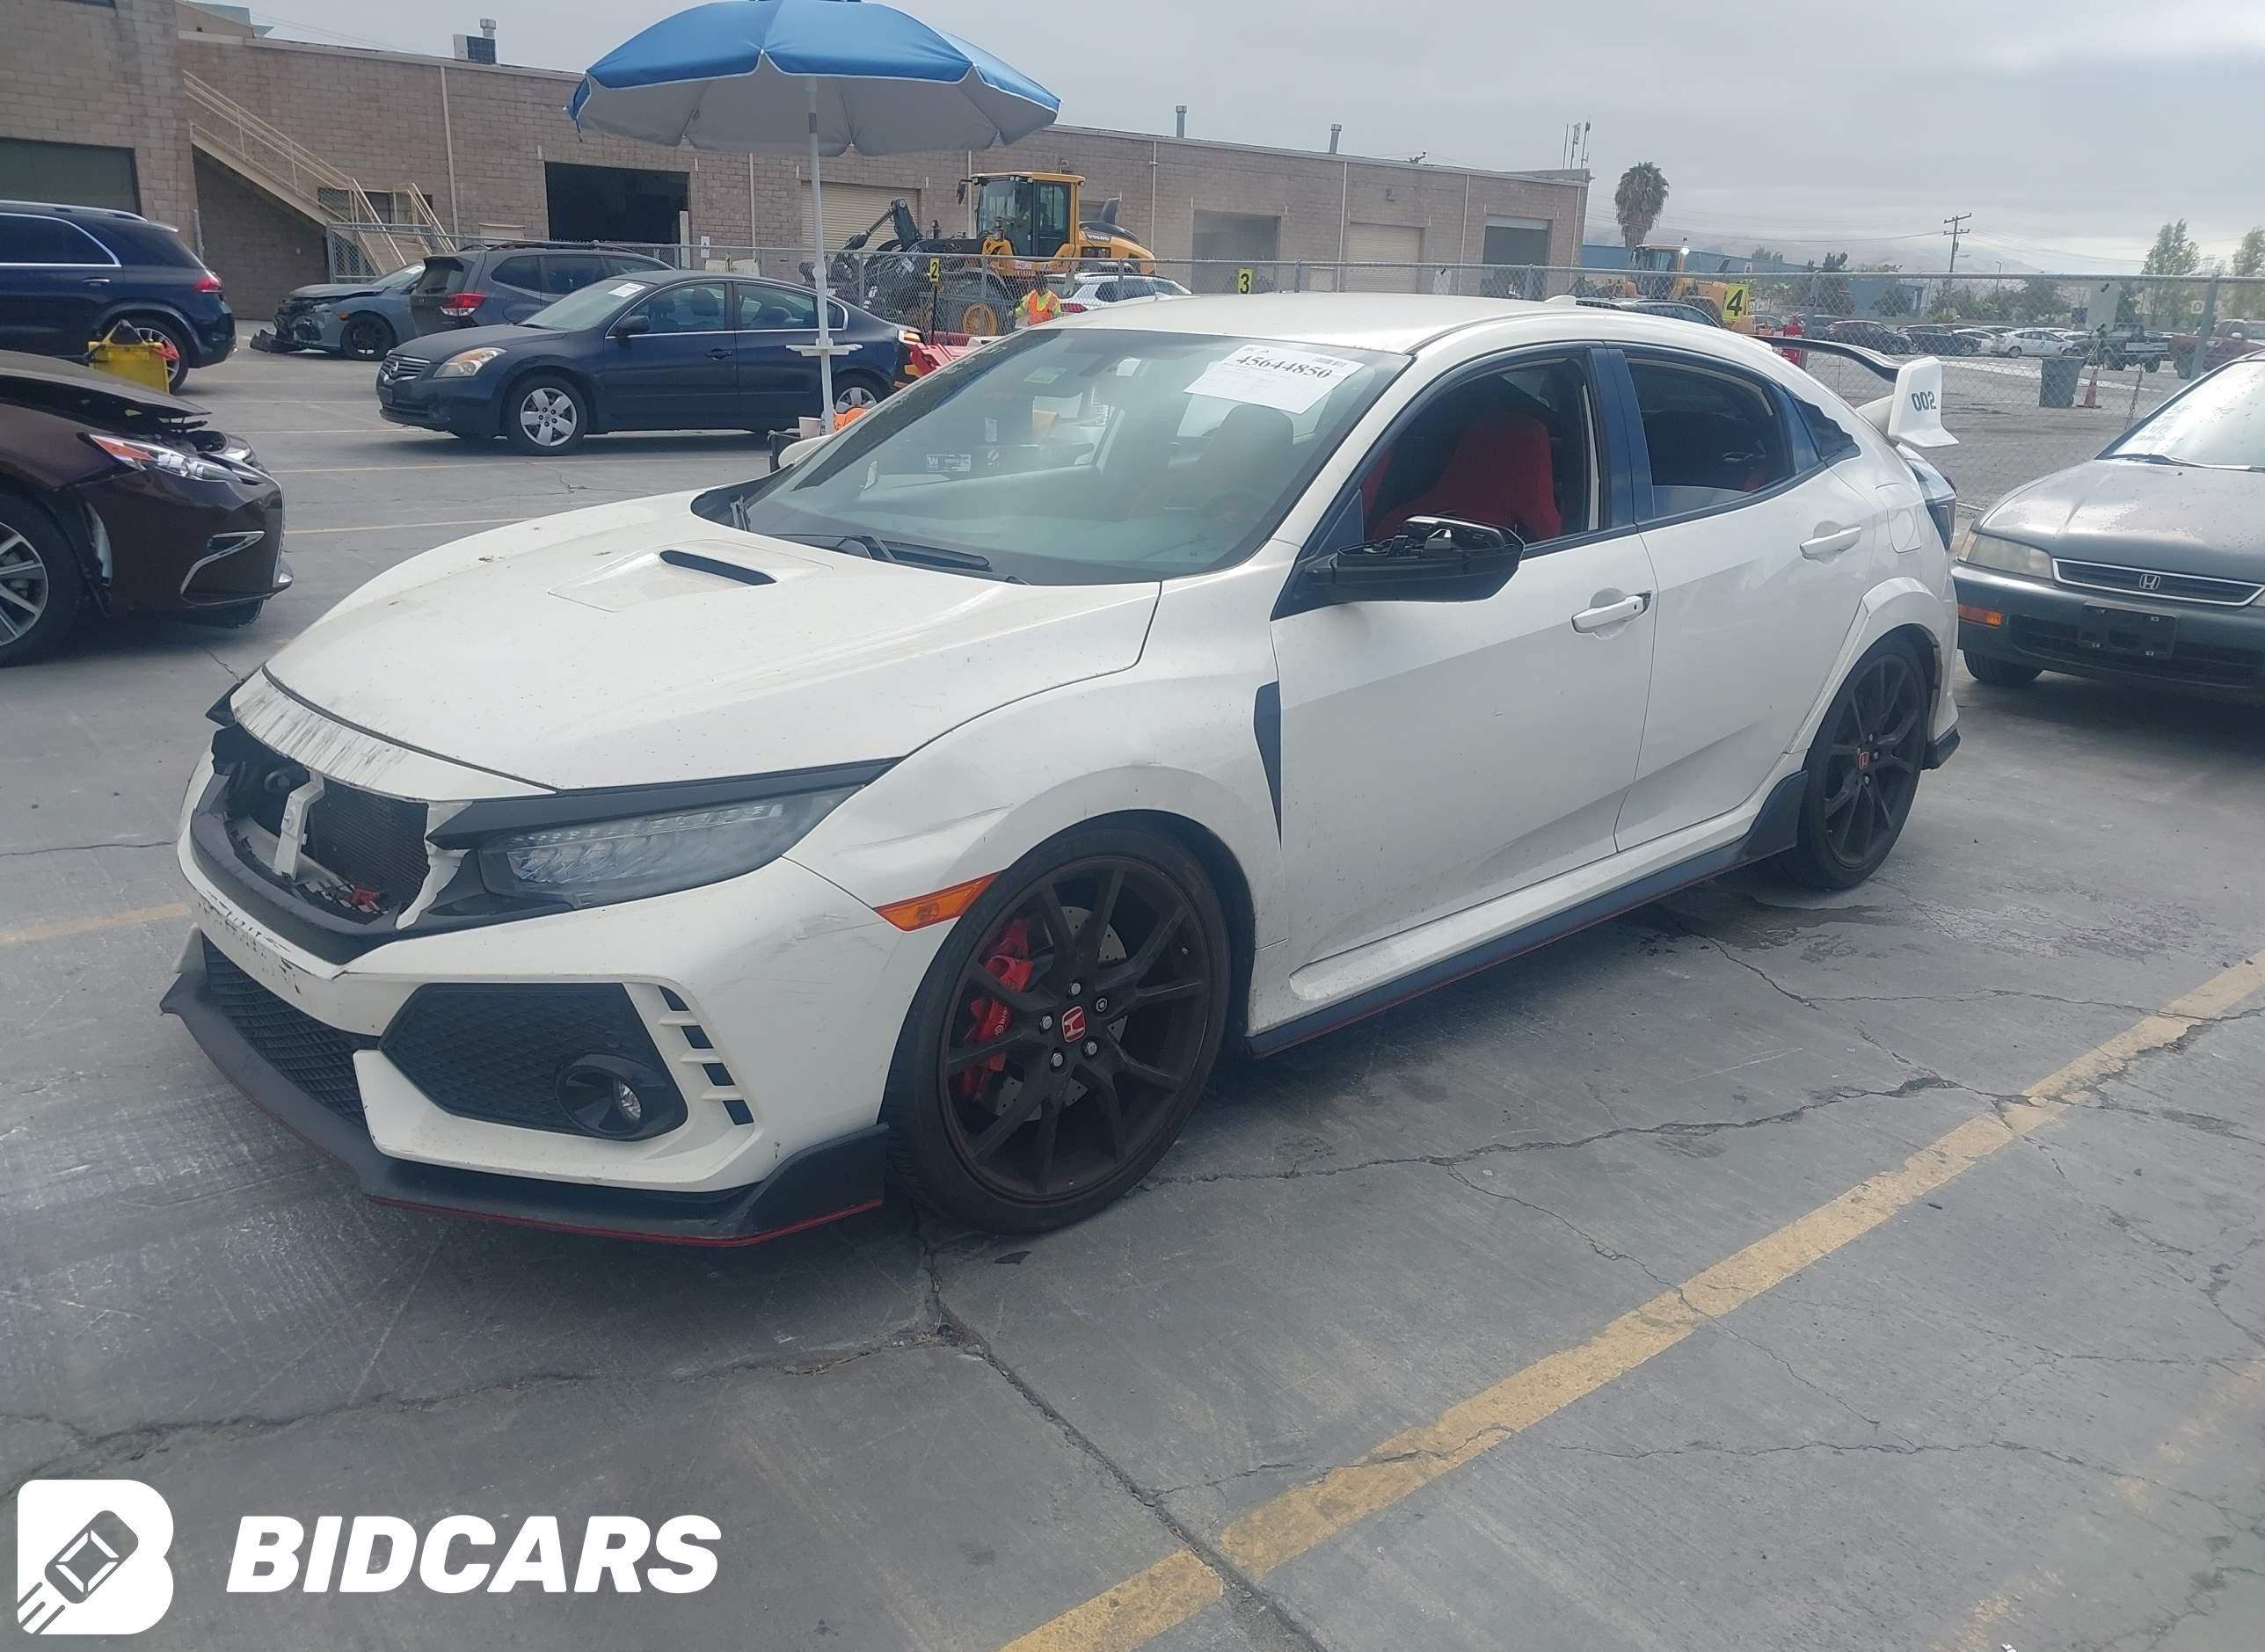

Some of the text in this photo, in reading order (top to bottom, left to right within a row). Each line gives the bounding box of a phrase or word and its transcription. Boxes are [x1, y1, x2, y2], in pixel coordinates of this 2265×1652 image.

[931, 261, 938, 279] 2
[1240, 273, 1249, 295] 3
[1726, 288, 1744, 317] 4
[1235, 354, 1333, 379] 45644850
[1911, 390, 1937, 411] 002
